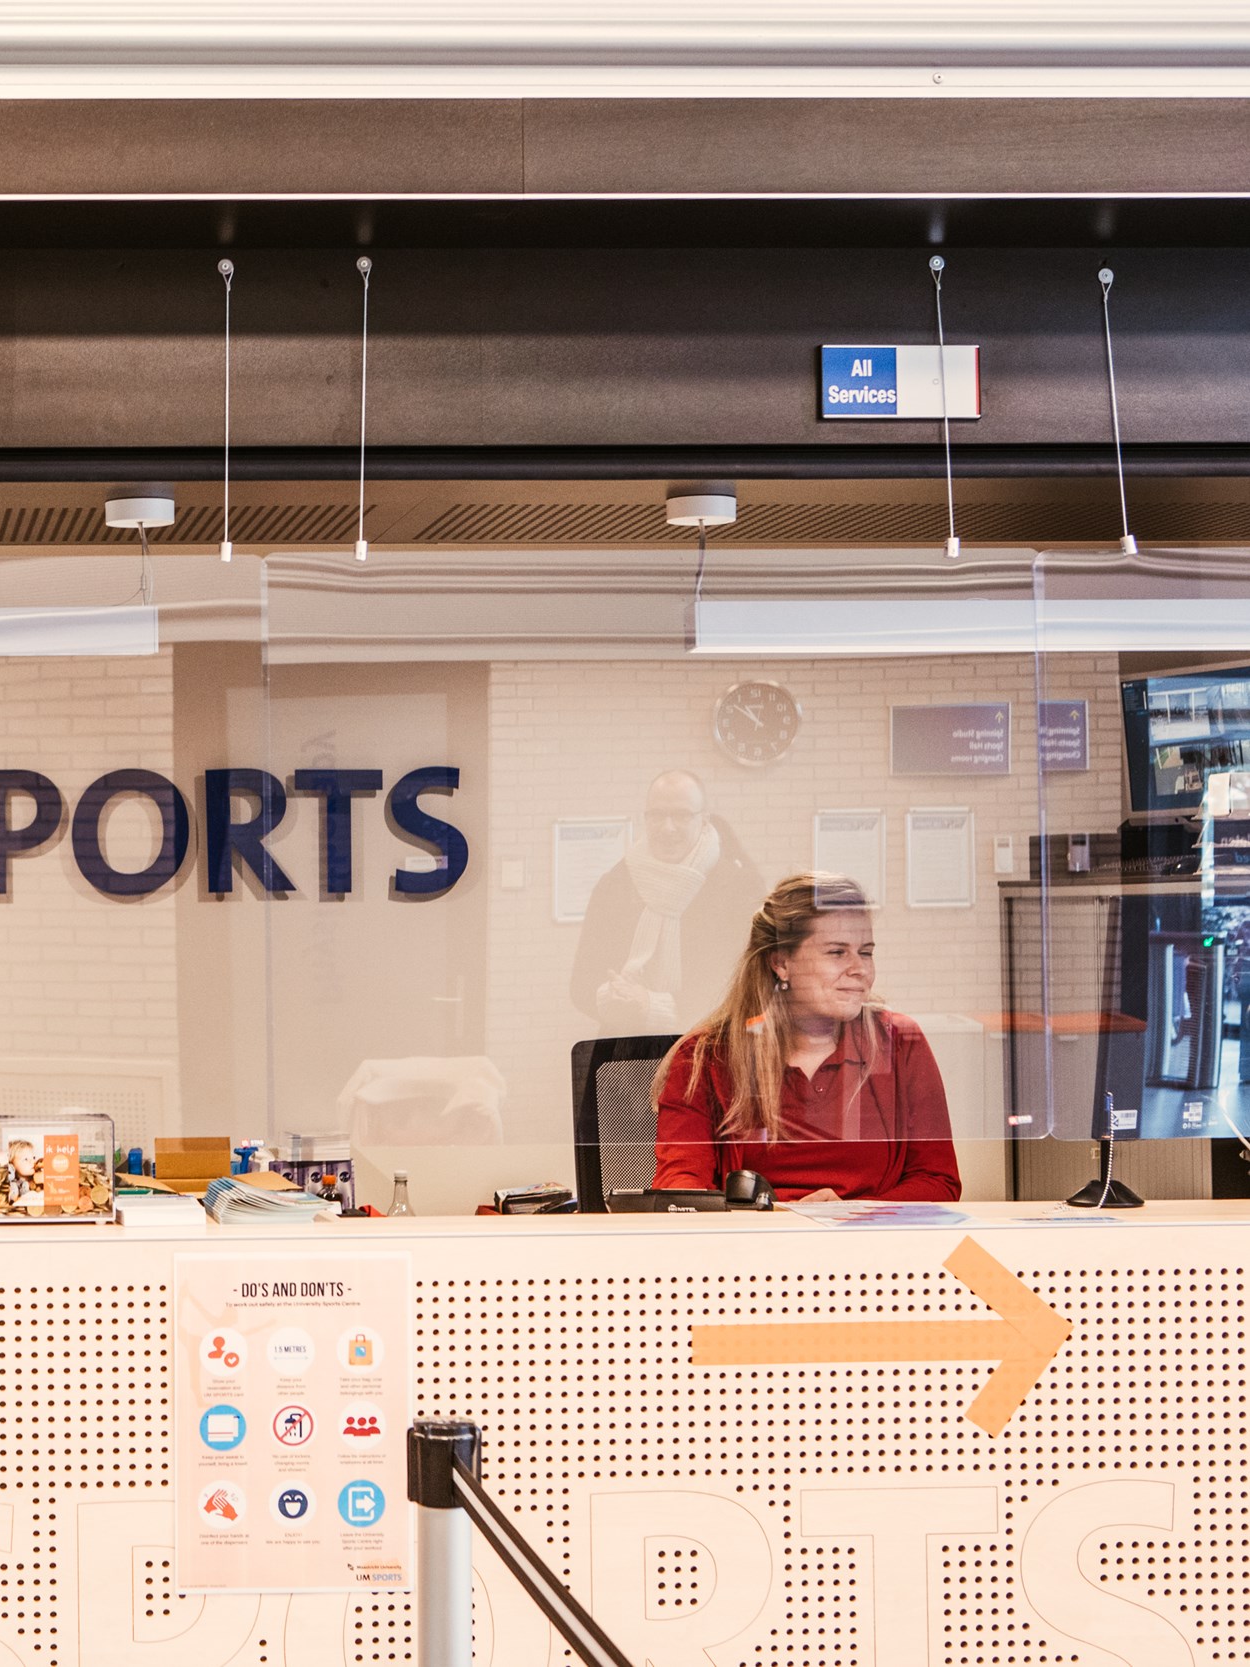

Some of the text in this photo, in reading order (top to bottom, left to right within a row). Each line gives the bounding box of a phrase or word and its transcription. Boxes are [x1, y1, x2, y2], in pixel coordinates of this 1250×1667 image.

[851, 359, 872, 377] All
[828, 385, 896, 404] Services
[242, 1283, 269, 1297] DO'S
[272, 1283, 297, 1297] AND
[301, 1282, 344, 1297] DON'TS
[372, 1573, 402, 1581] SPORTS
